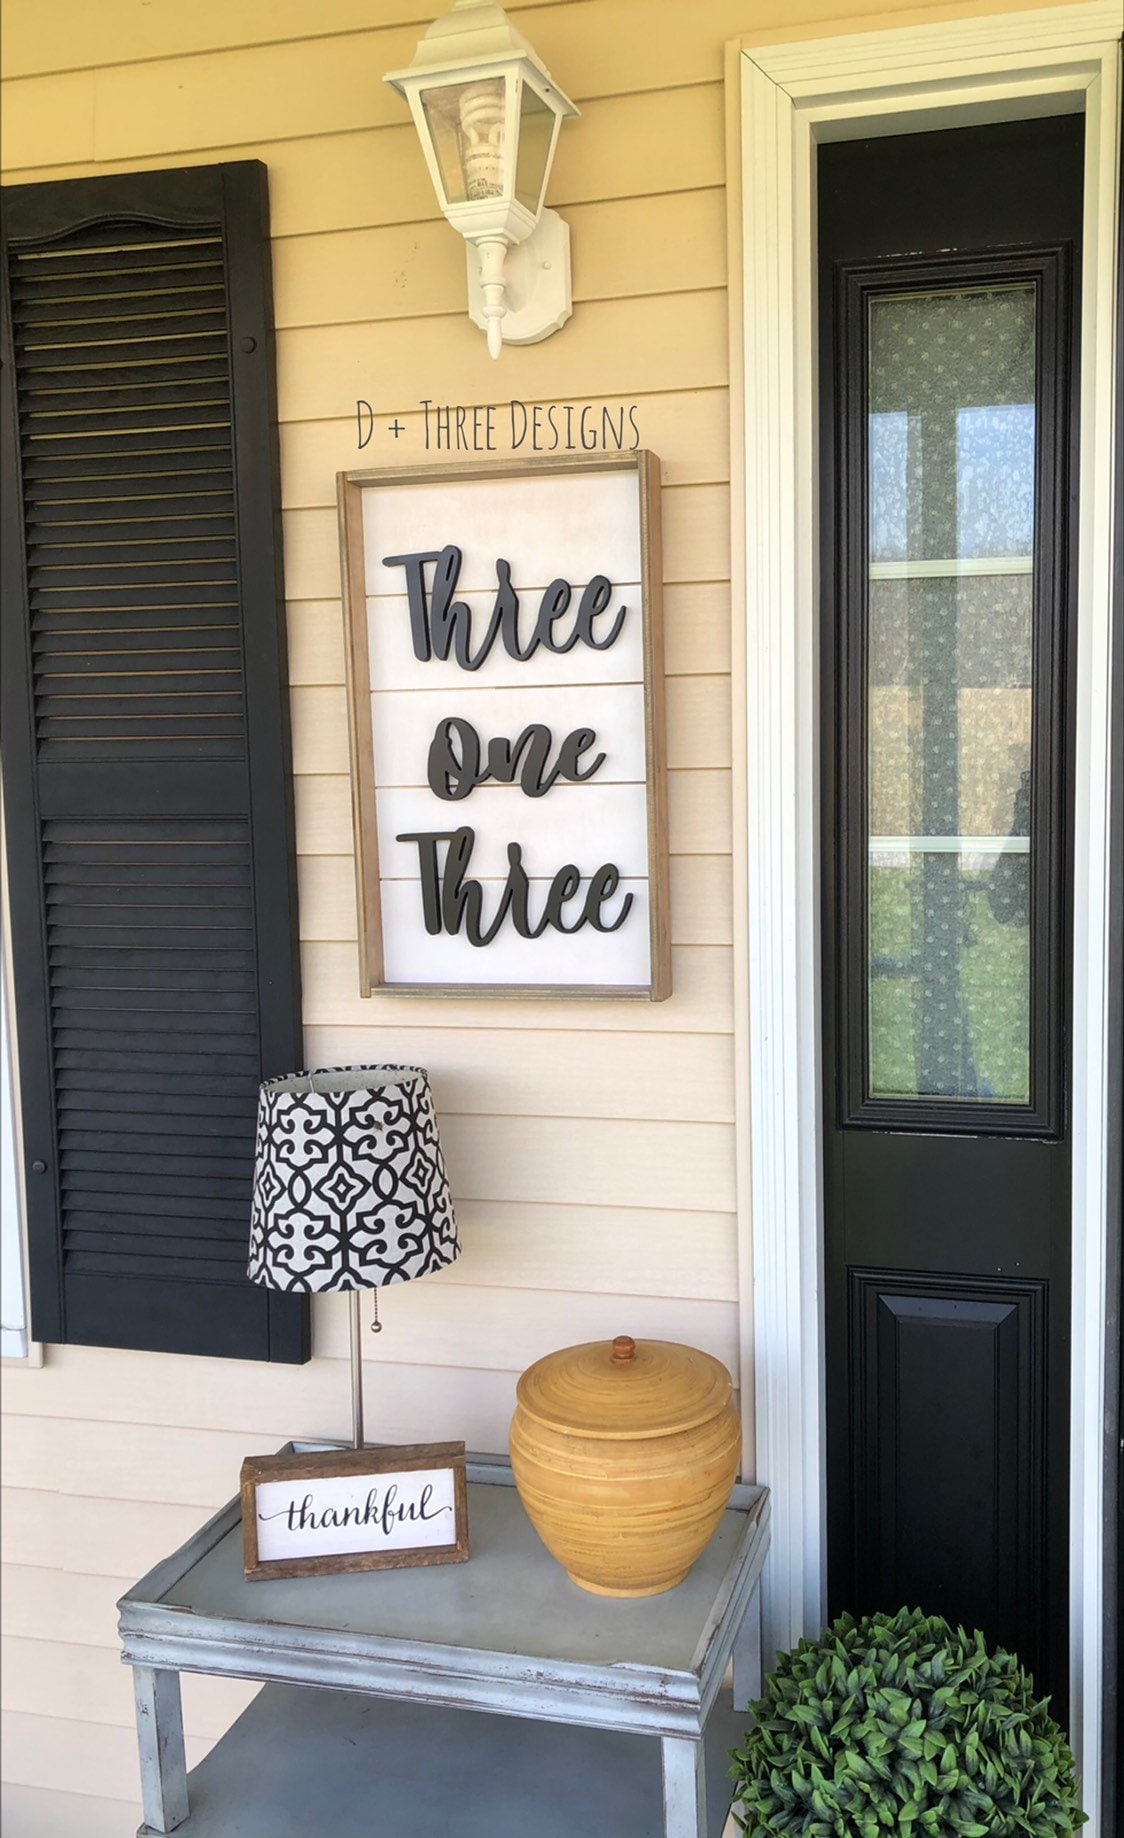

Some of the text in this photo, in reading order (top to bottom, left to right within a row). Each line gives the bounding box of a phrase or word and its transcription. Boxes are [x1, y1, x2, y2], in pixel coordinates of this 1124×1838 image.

[382, 545, 627, 672] Three
[396, 826, 633, 948] Three
[258, 1484, 452, 1536] thankful
